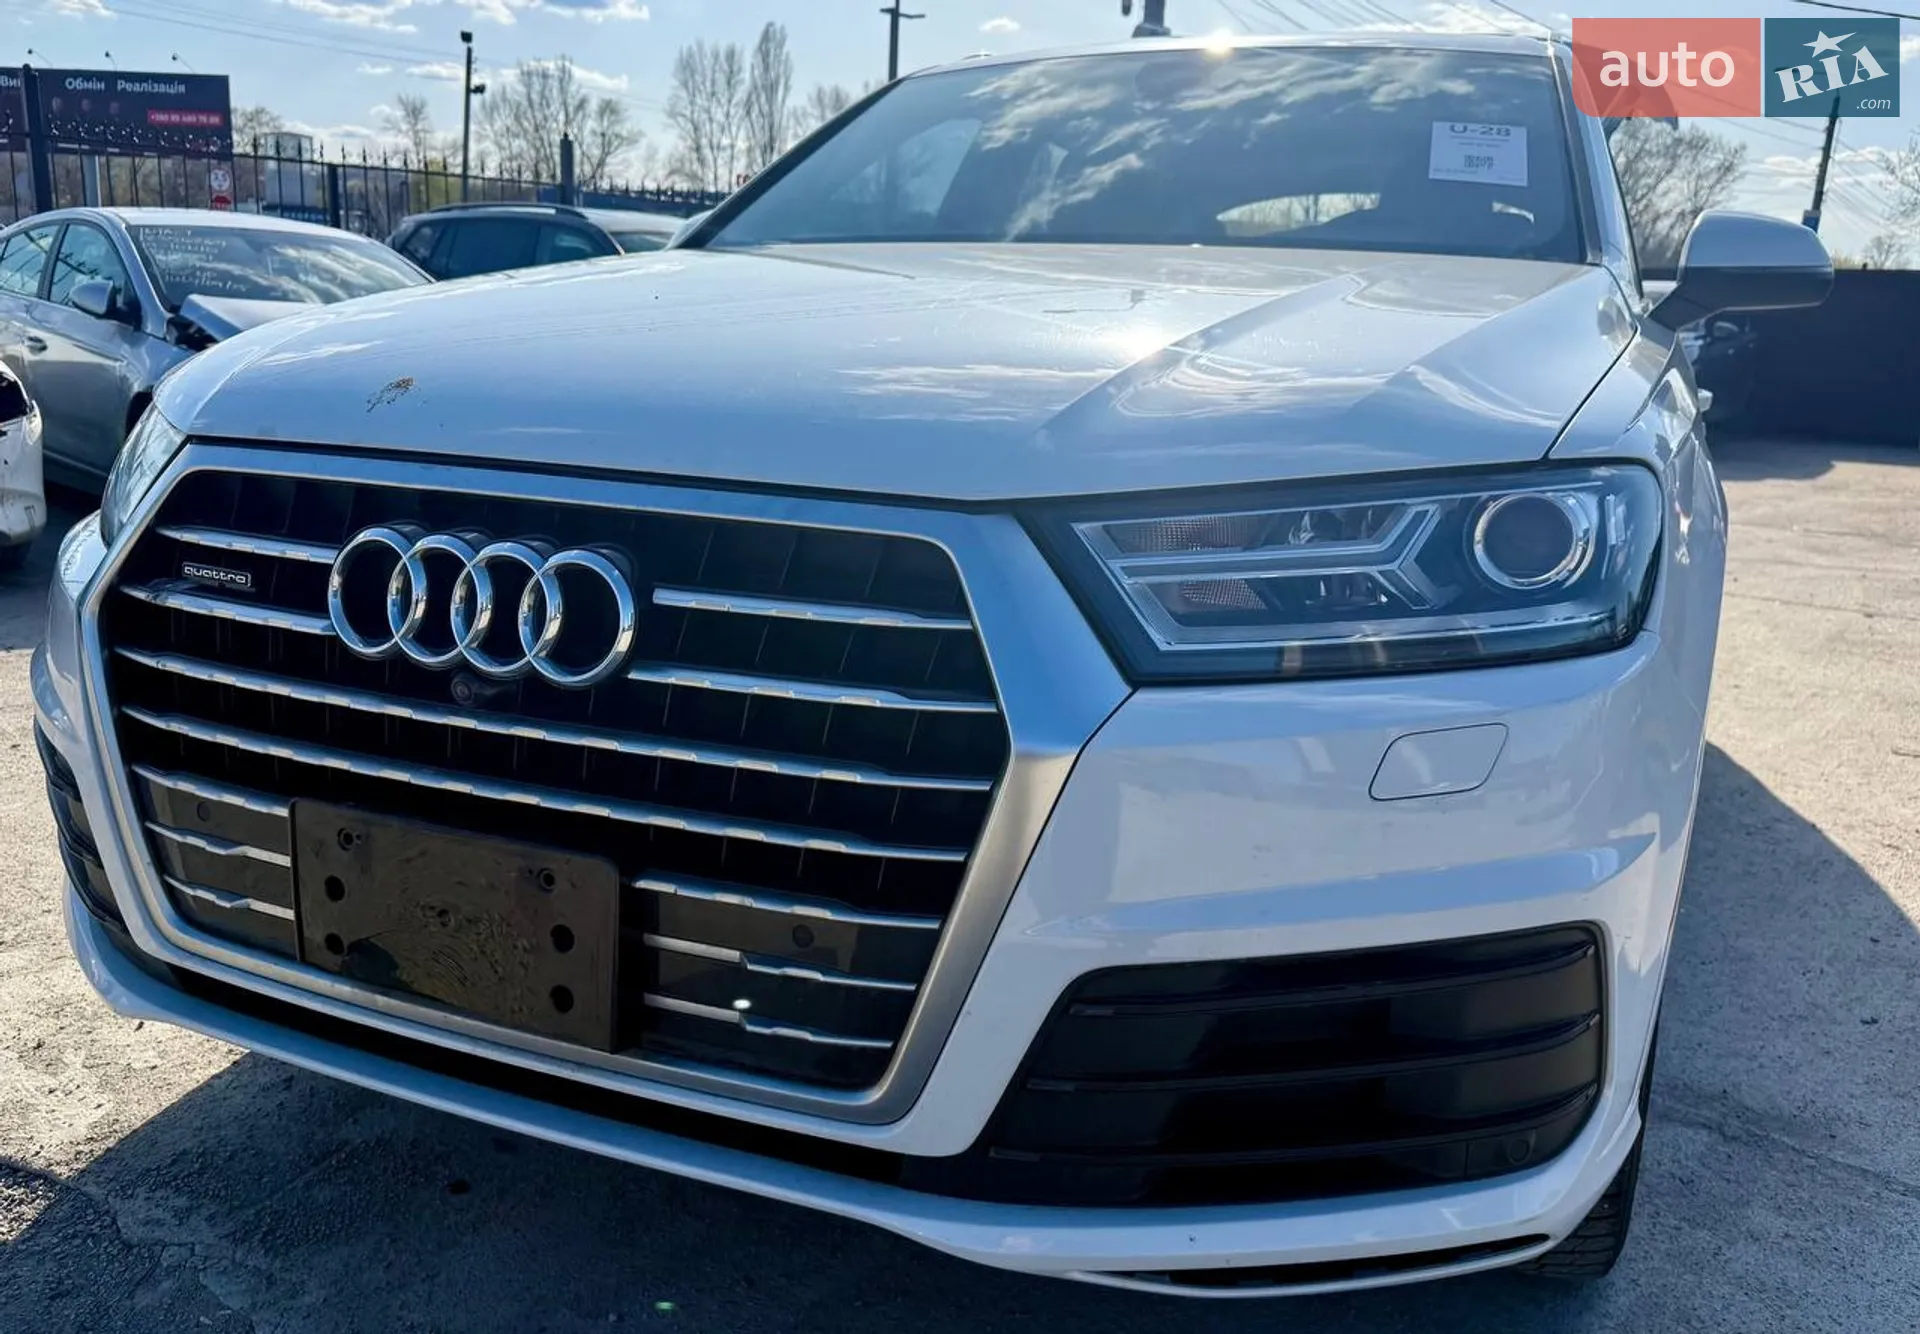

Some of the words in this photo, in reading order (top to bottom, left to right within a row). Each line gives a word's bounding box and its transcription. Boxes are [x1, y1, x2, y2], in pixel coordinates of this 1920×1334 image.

[65, 77, 105, 91] Обмін
[117, 79, 186, 94] Реалізація
[184, 566, 247, 584] quattro
